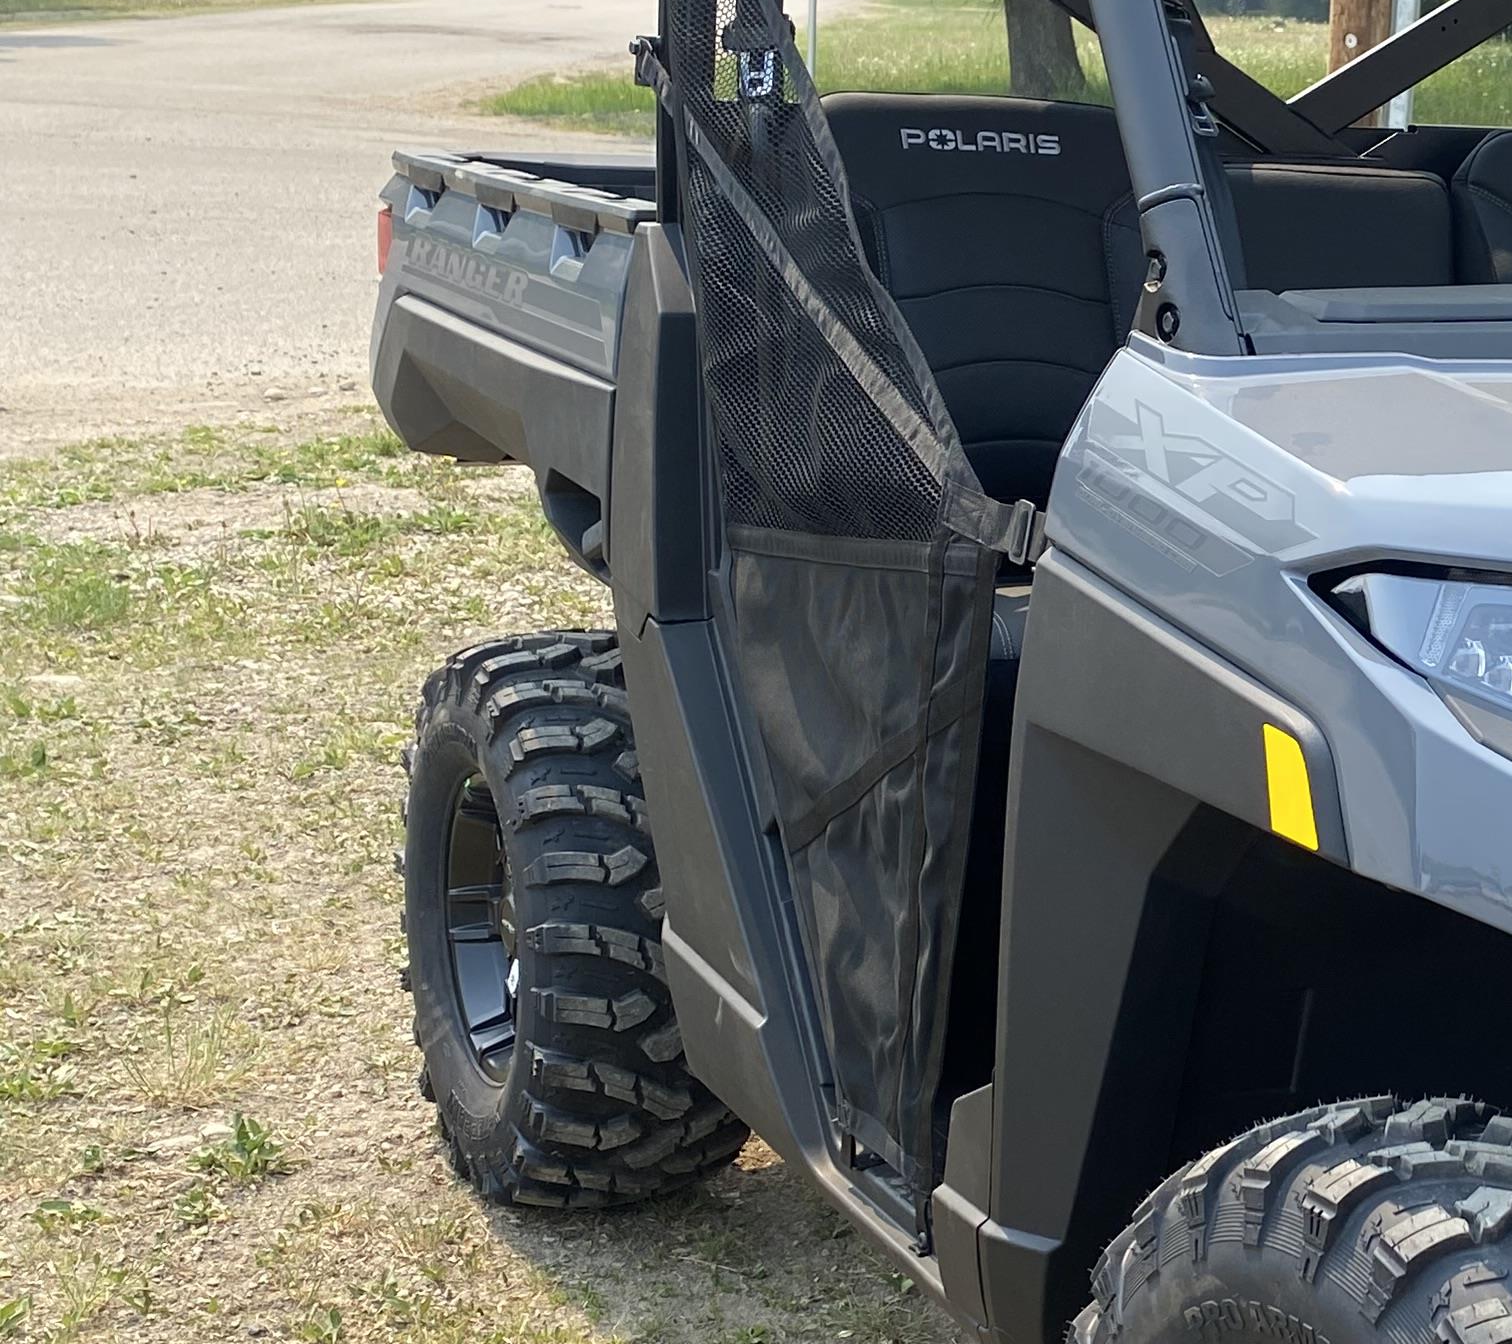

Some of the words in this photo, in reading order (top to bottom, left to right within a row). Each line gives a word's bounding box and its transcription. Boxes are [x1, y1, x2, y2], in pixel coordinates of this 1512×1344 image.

[900, 128, 1062, 155] POLARIS
[408, 233, 530, 306] RANGER
[1107, 398, 1297, 522] XP
[1184, 1298, 1247, 1335] PRO
